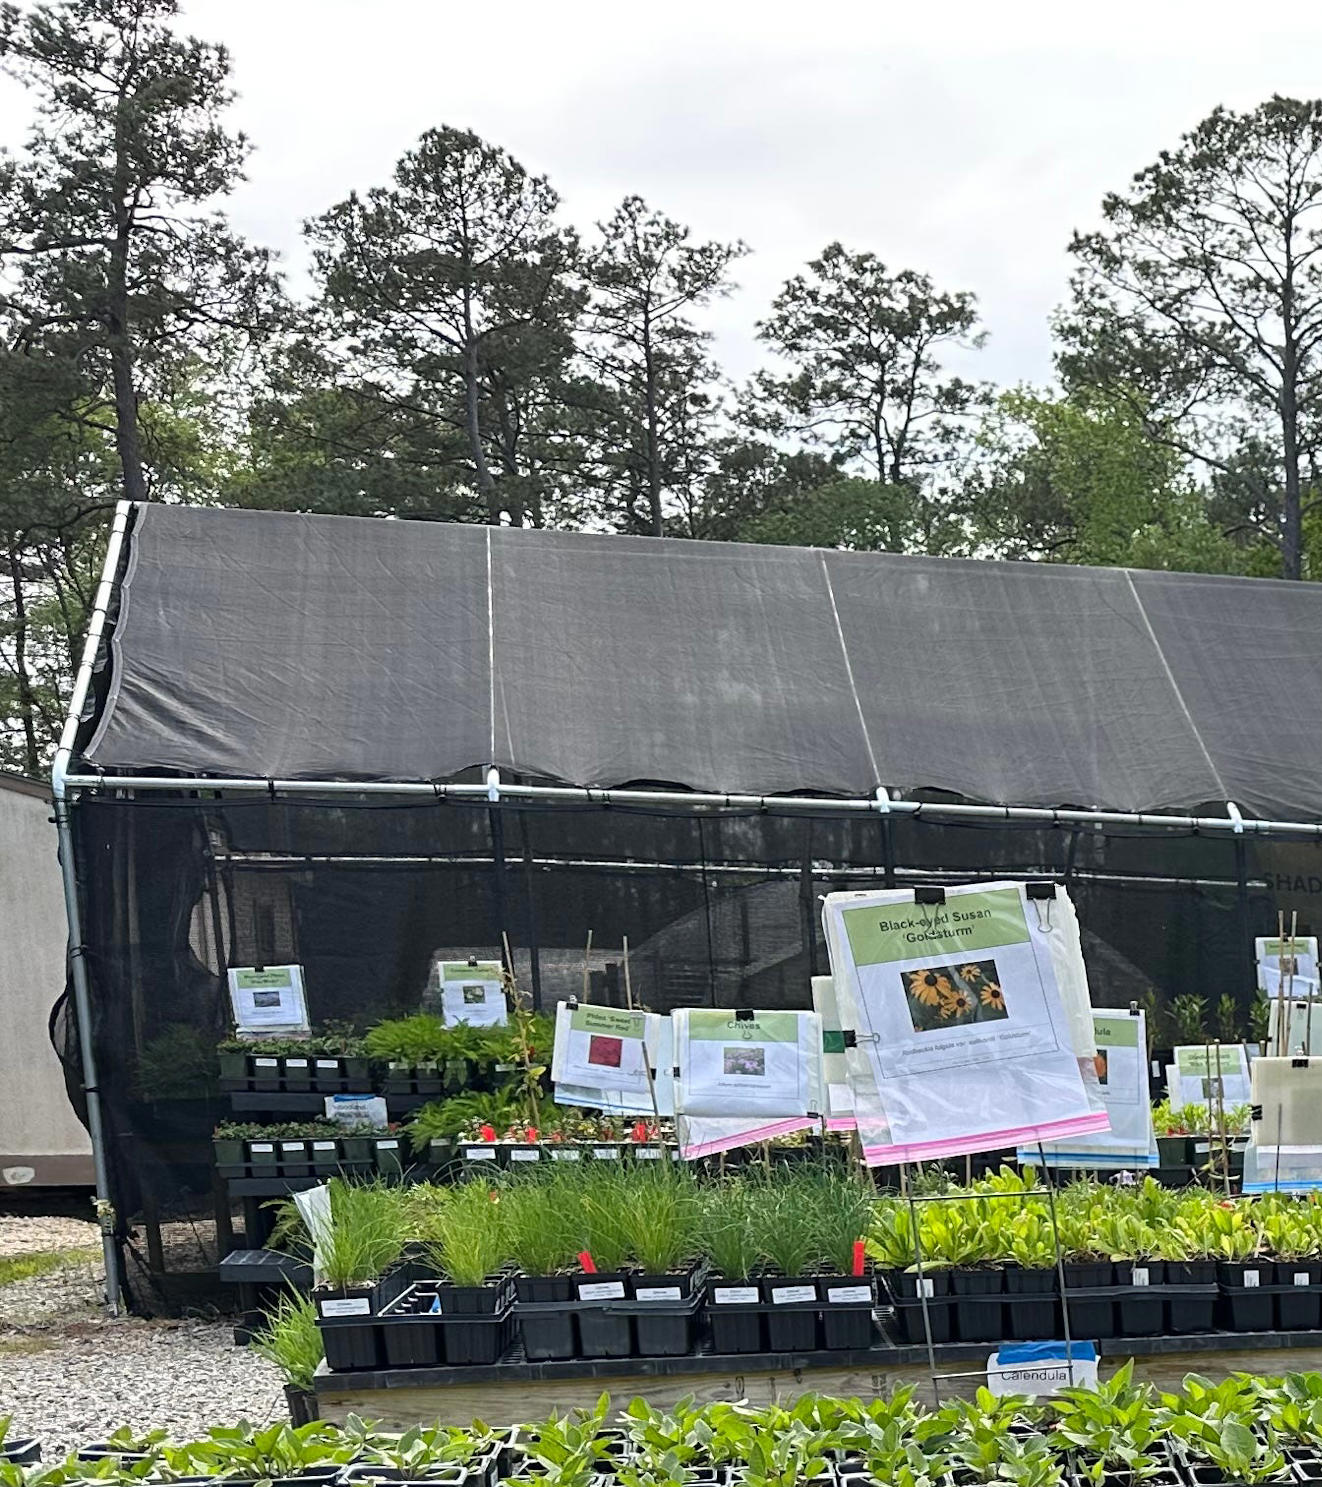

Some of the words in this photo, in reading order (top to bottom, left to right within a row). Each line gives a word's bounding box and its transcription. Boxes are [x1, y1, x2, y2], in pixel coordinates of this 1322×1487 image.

[953, 908, 992, 923] Susan
[727, 1020, 761, 1030] Chives
[1001, 1368, 1067, 1381] Calendula
